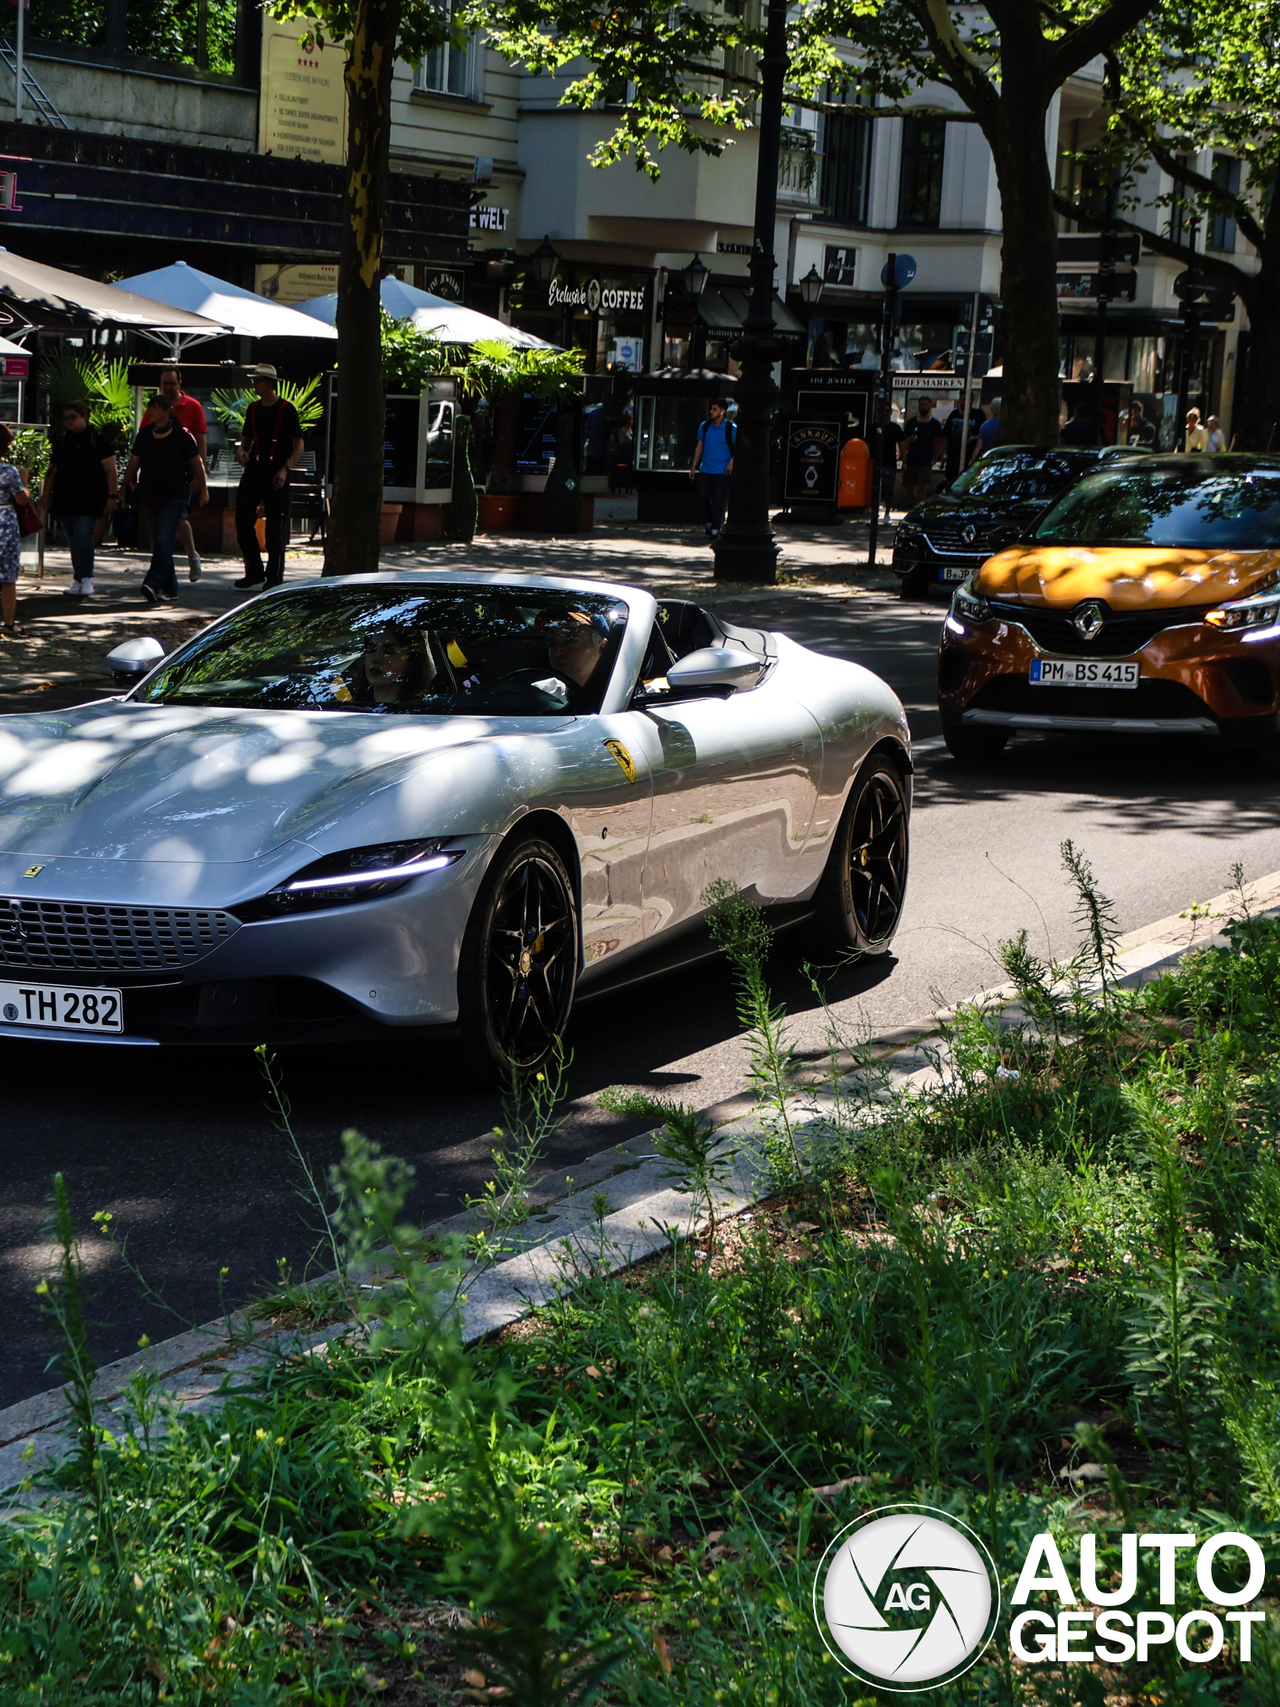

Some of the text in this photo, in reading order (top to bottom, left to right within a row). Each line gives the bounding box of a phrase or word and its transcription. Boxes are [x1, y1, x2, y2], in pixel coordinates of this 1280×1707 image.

[478, 205, 510, 231] WELT
[548, 279, 645, 311] Exclusive COFFEE
[894, 378, 963, 387] BRIEFMARKEN
[1041, 662, 1136, 682] PM BS 415
[19, 988, 57, 1022] TH
[63, 992, 119, 1027] 282
